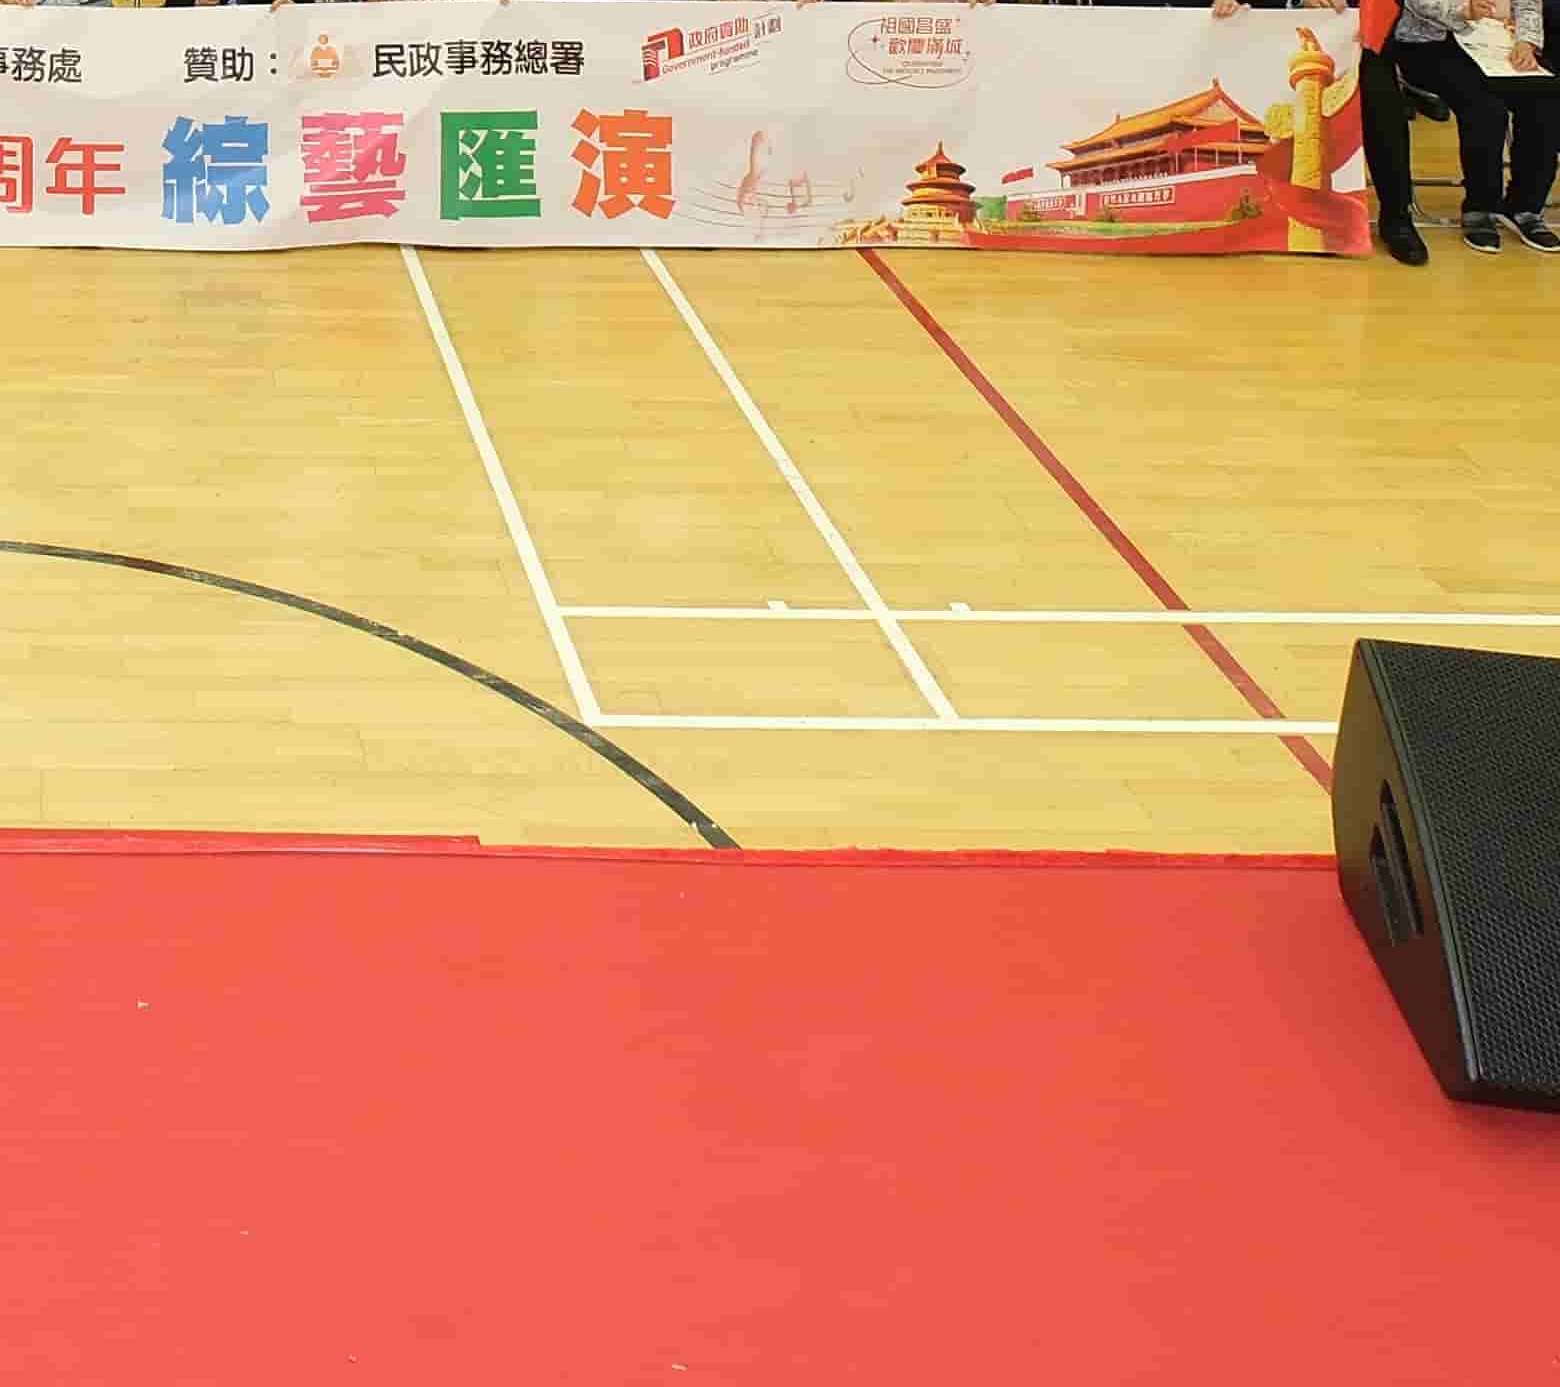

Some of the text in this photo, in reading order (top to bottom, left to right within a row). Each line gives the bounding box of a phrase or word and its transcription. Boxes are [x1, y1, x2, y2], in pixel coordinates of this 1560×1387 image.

[372, 39, 585, 78] 民政事務總署
[161, 108, 676, 225] 綜藝匯演
